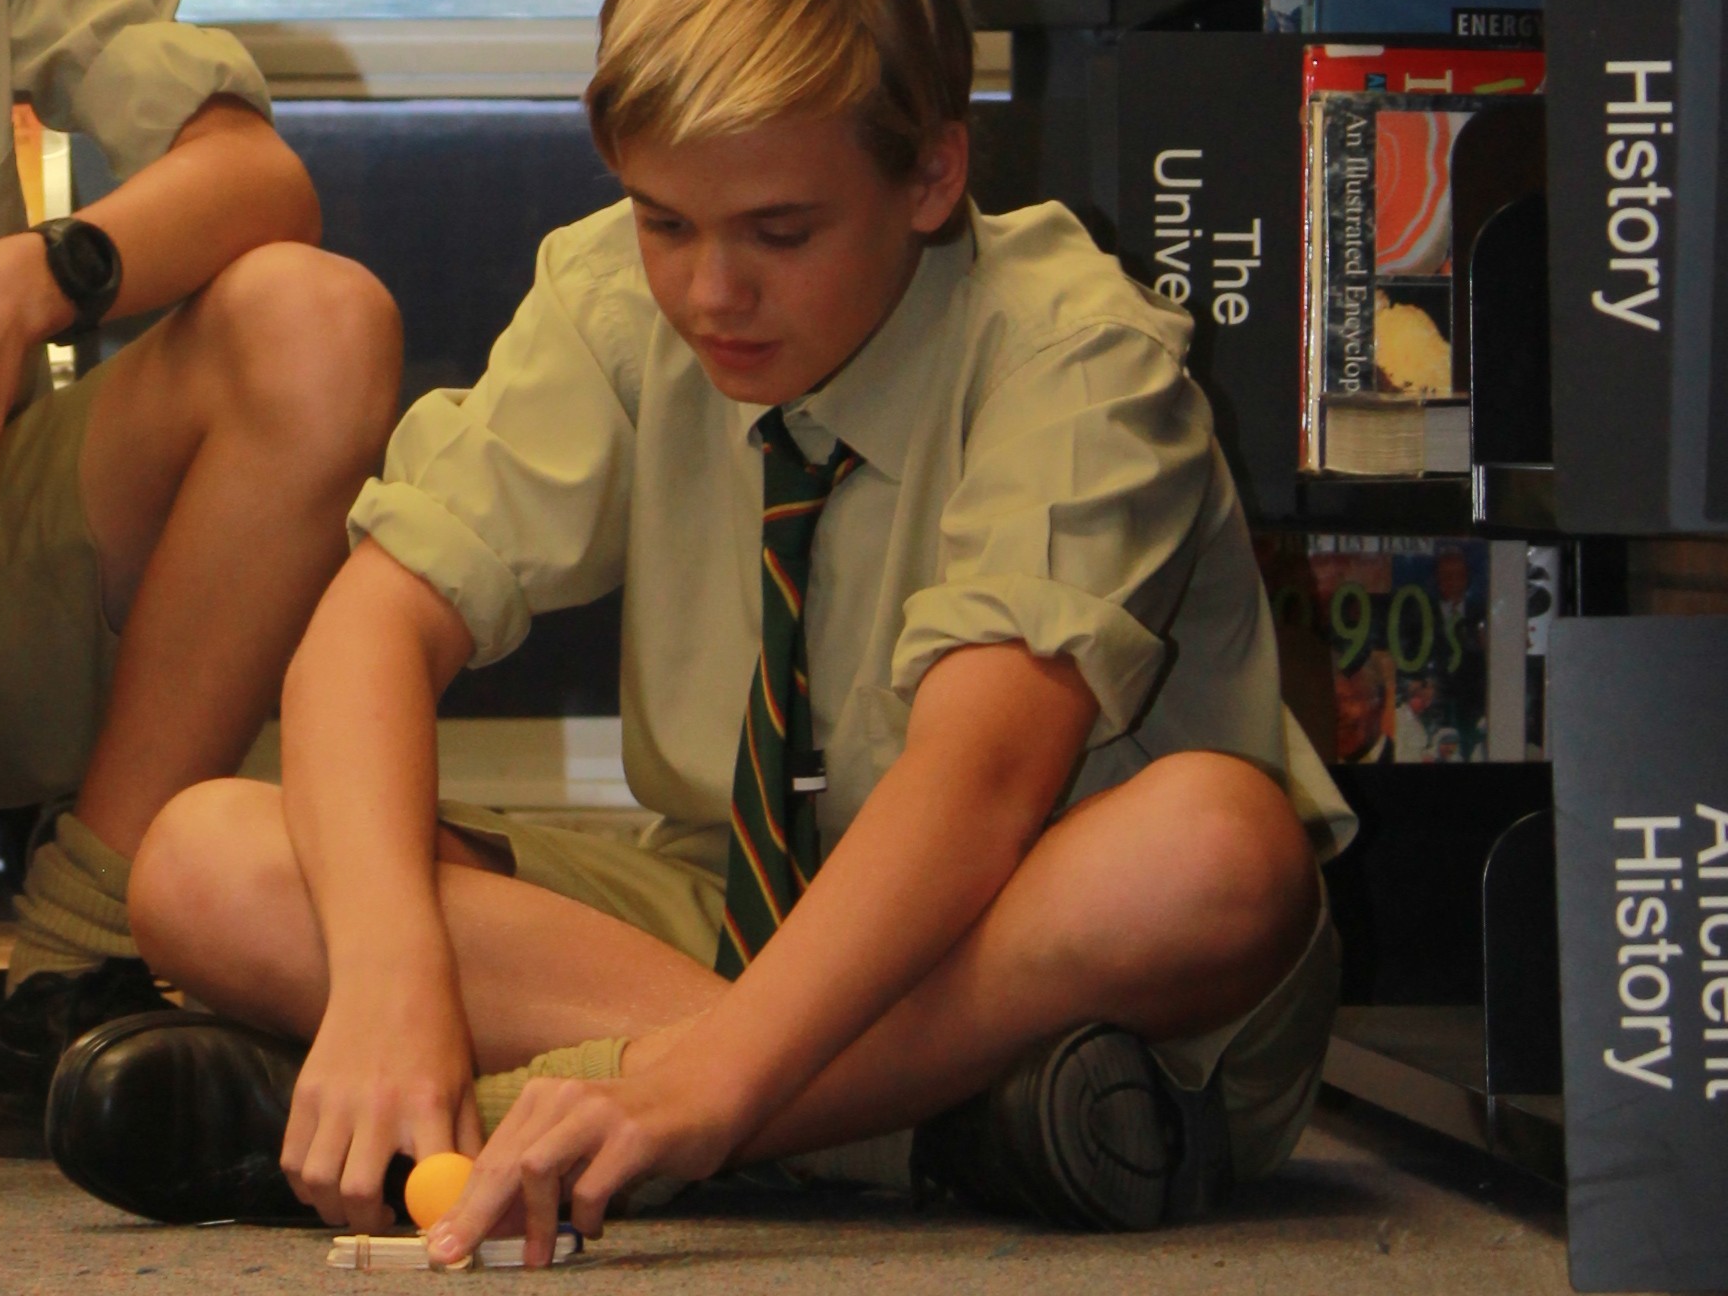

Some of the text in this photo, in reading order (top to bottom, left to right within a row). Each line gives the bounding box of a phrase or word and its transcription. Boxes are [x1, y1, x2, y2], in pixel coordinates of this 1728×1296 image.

[1346, 110, 1367, 147] An
[1591, 60, 1673, 331] History
[1153, 149, 1203, 305] Unive
[1212, 218, 1261, 325] The
[1345, 158, 1369, 275] Illustrated
[1603, 816, 1683, 1089] History
